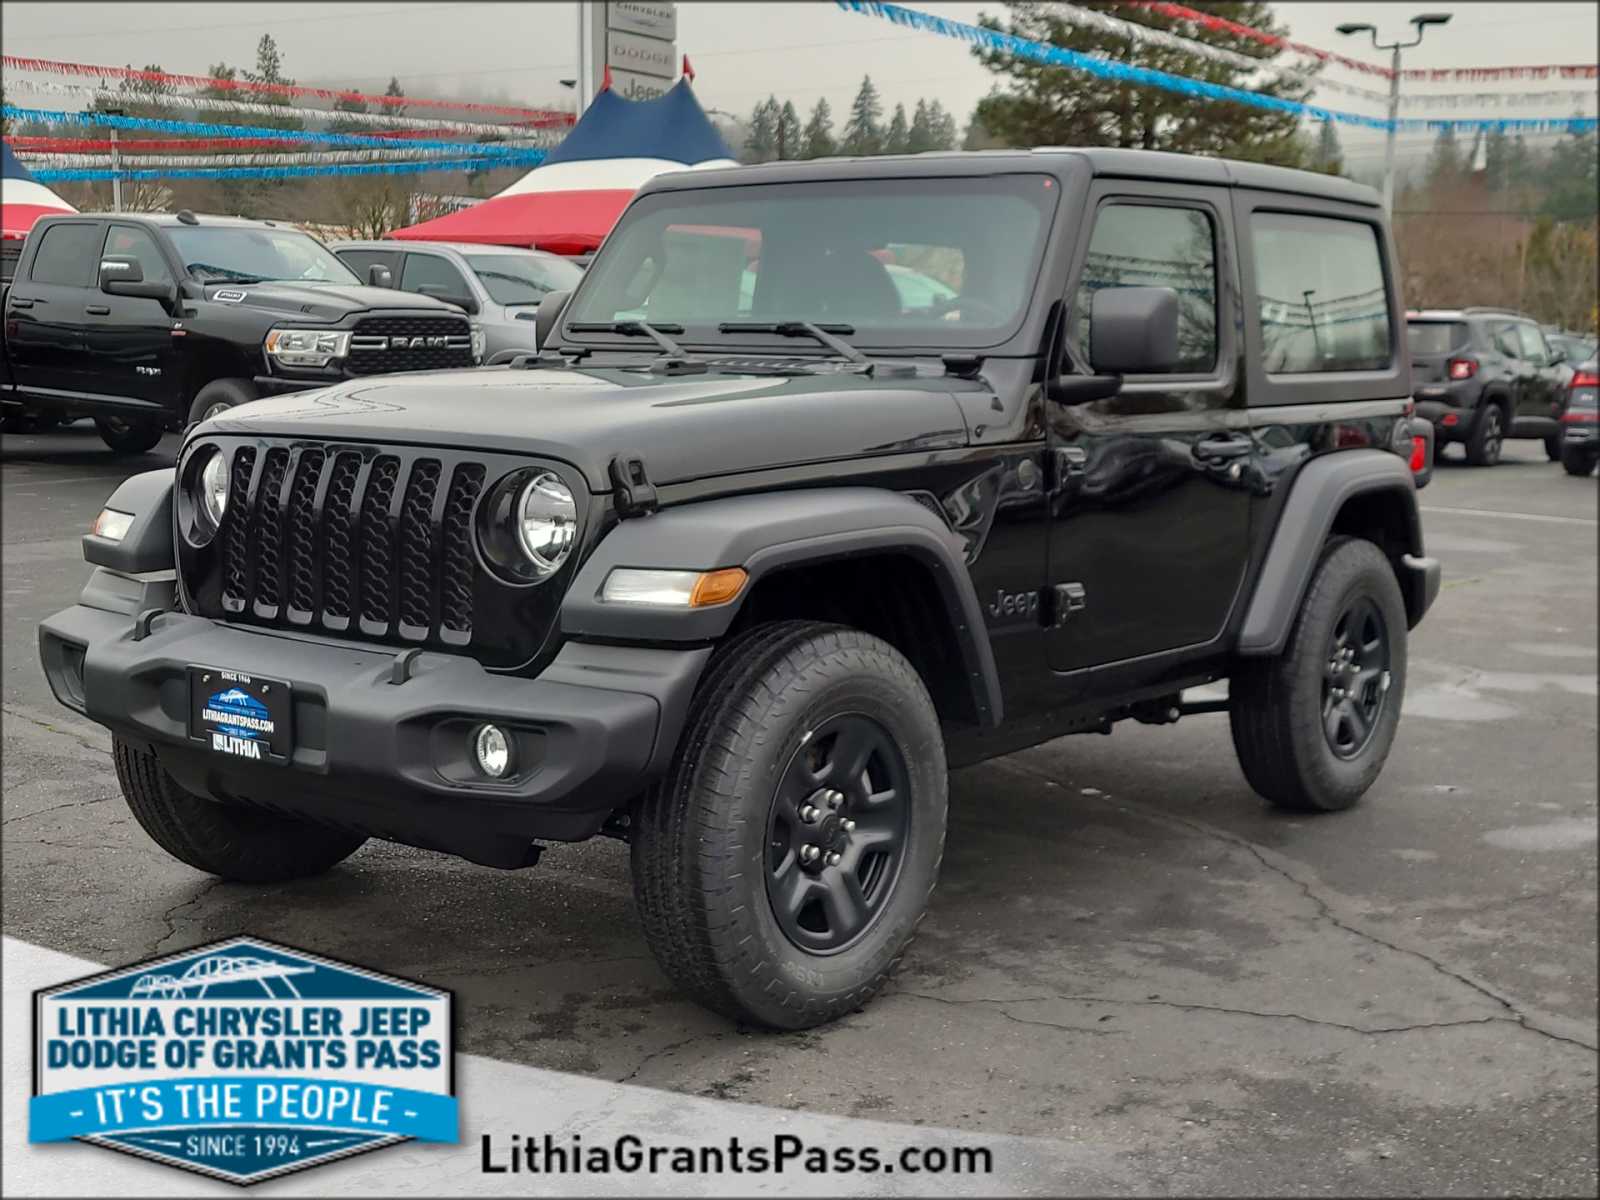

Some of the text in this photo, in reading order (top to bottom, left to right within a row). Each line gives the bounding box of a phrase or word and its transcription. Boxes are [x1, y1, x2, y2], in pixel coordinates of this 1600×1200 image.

[614, 45, 672, 65] DODGE
[390, 335, 448, 349] RAM
[136, 366, 161, 376] RAM
[989, 589, 1039, 617] Jeep
[202, 708, 274, 734] LITHIAGRANTSPASS.COM
[223, 733, 261, 760] LITHIA
